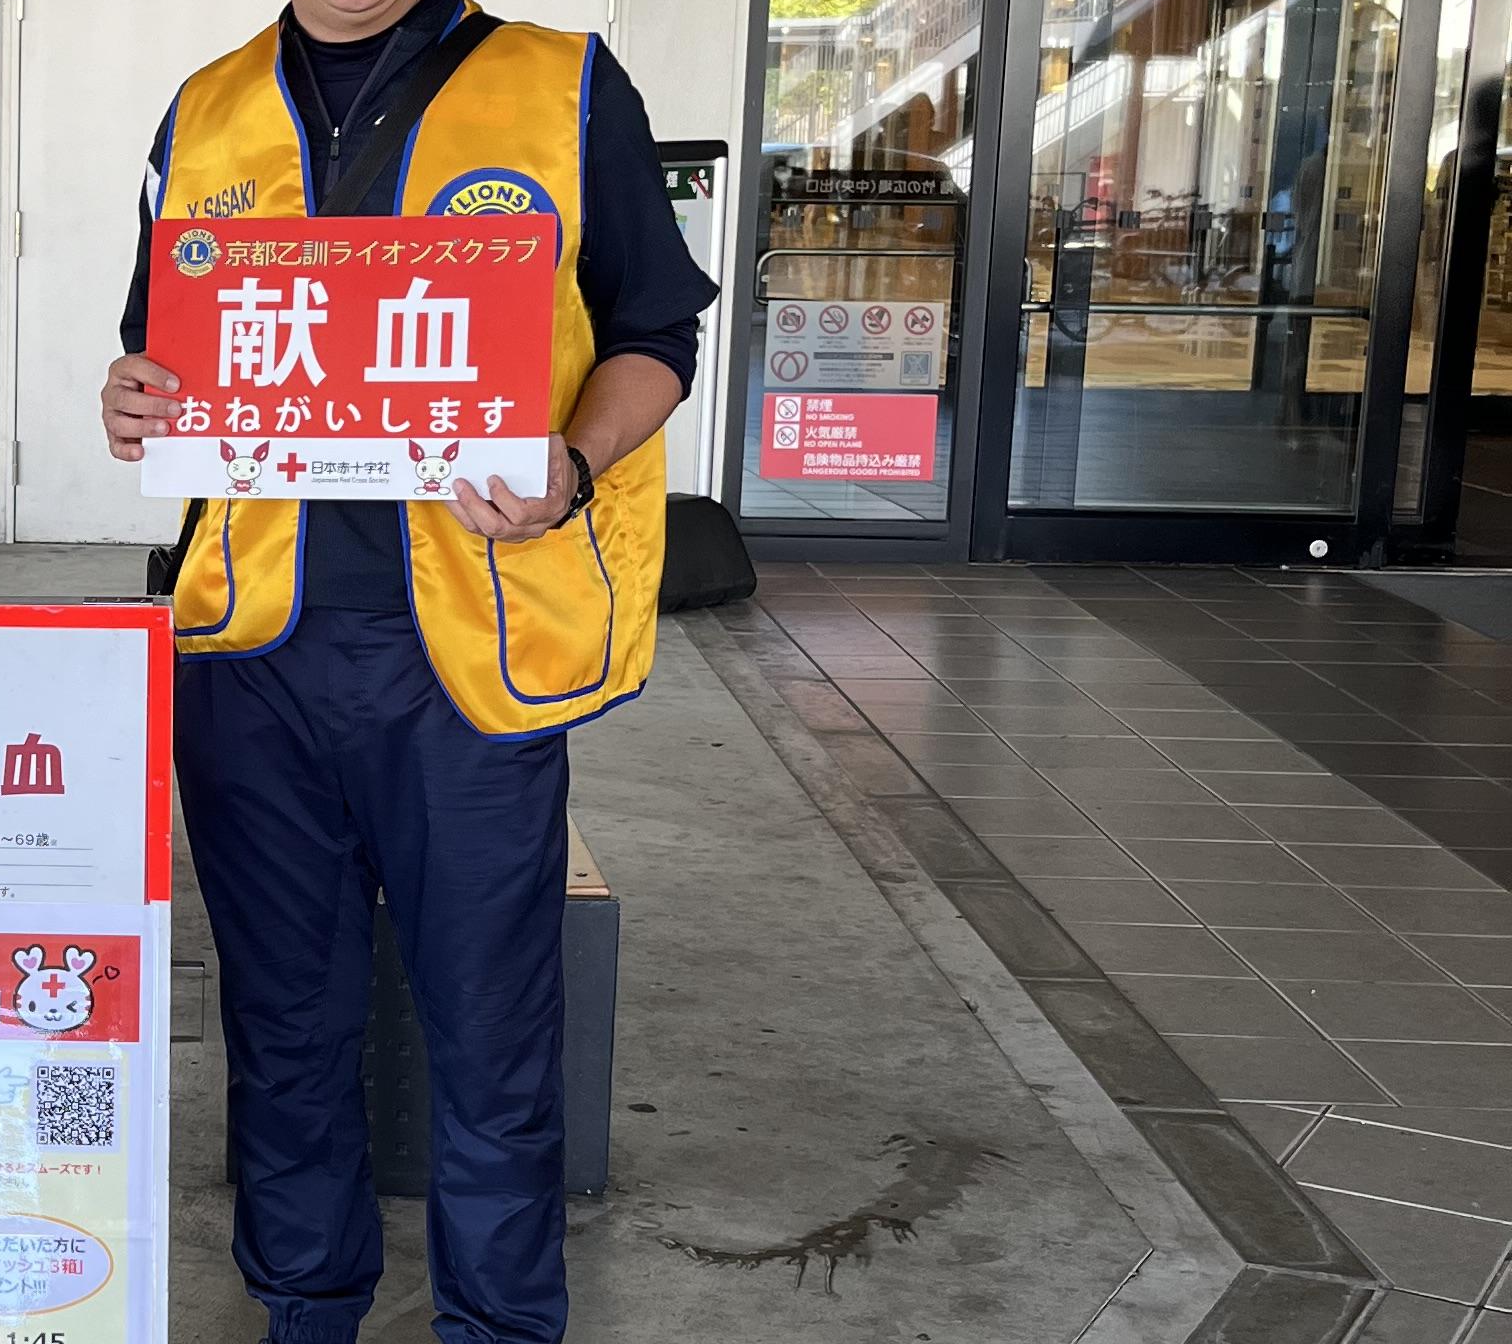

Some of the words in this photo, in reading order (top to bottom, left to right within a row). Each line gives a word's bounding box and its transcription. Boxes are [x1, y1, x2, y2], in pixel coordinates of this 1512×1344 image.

[456, 184, 527, 210] LIONS
[182, 230, 212, 241] LIONS
[191, 244, 204, 261] L
[225, 235, 541, 267] 京都乙訓ライオンズクラブ
[806, 399, 833, 412] 禁煙
[176, 396, 515, 434] おねがいします
[805, 426, 857, 439] 火気厳禁
[803, 453, 921, 467] 危険物品持込み厳禁
[312, 461, 390, 474] 日本赤十字社
[849, 468, 877, 476] GOODS
